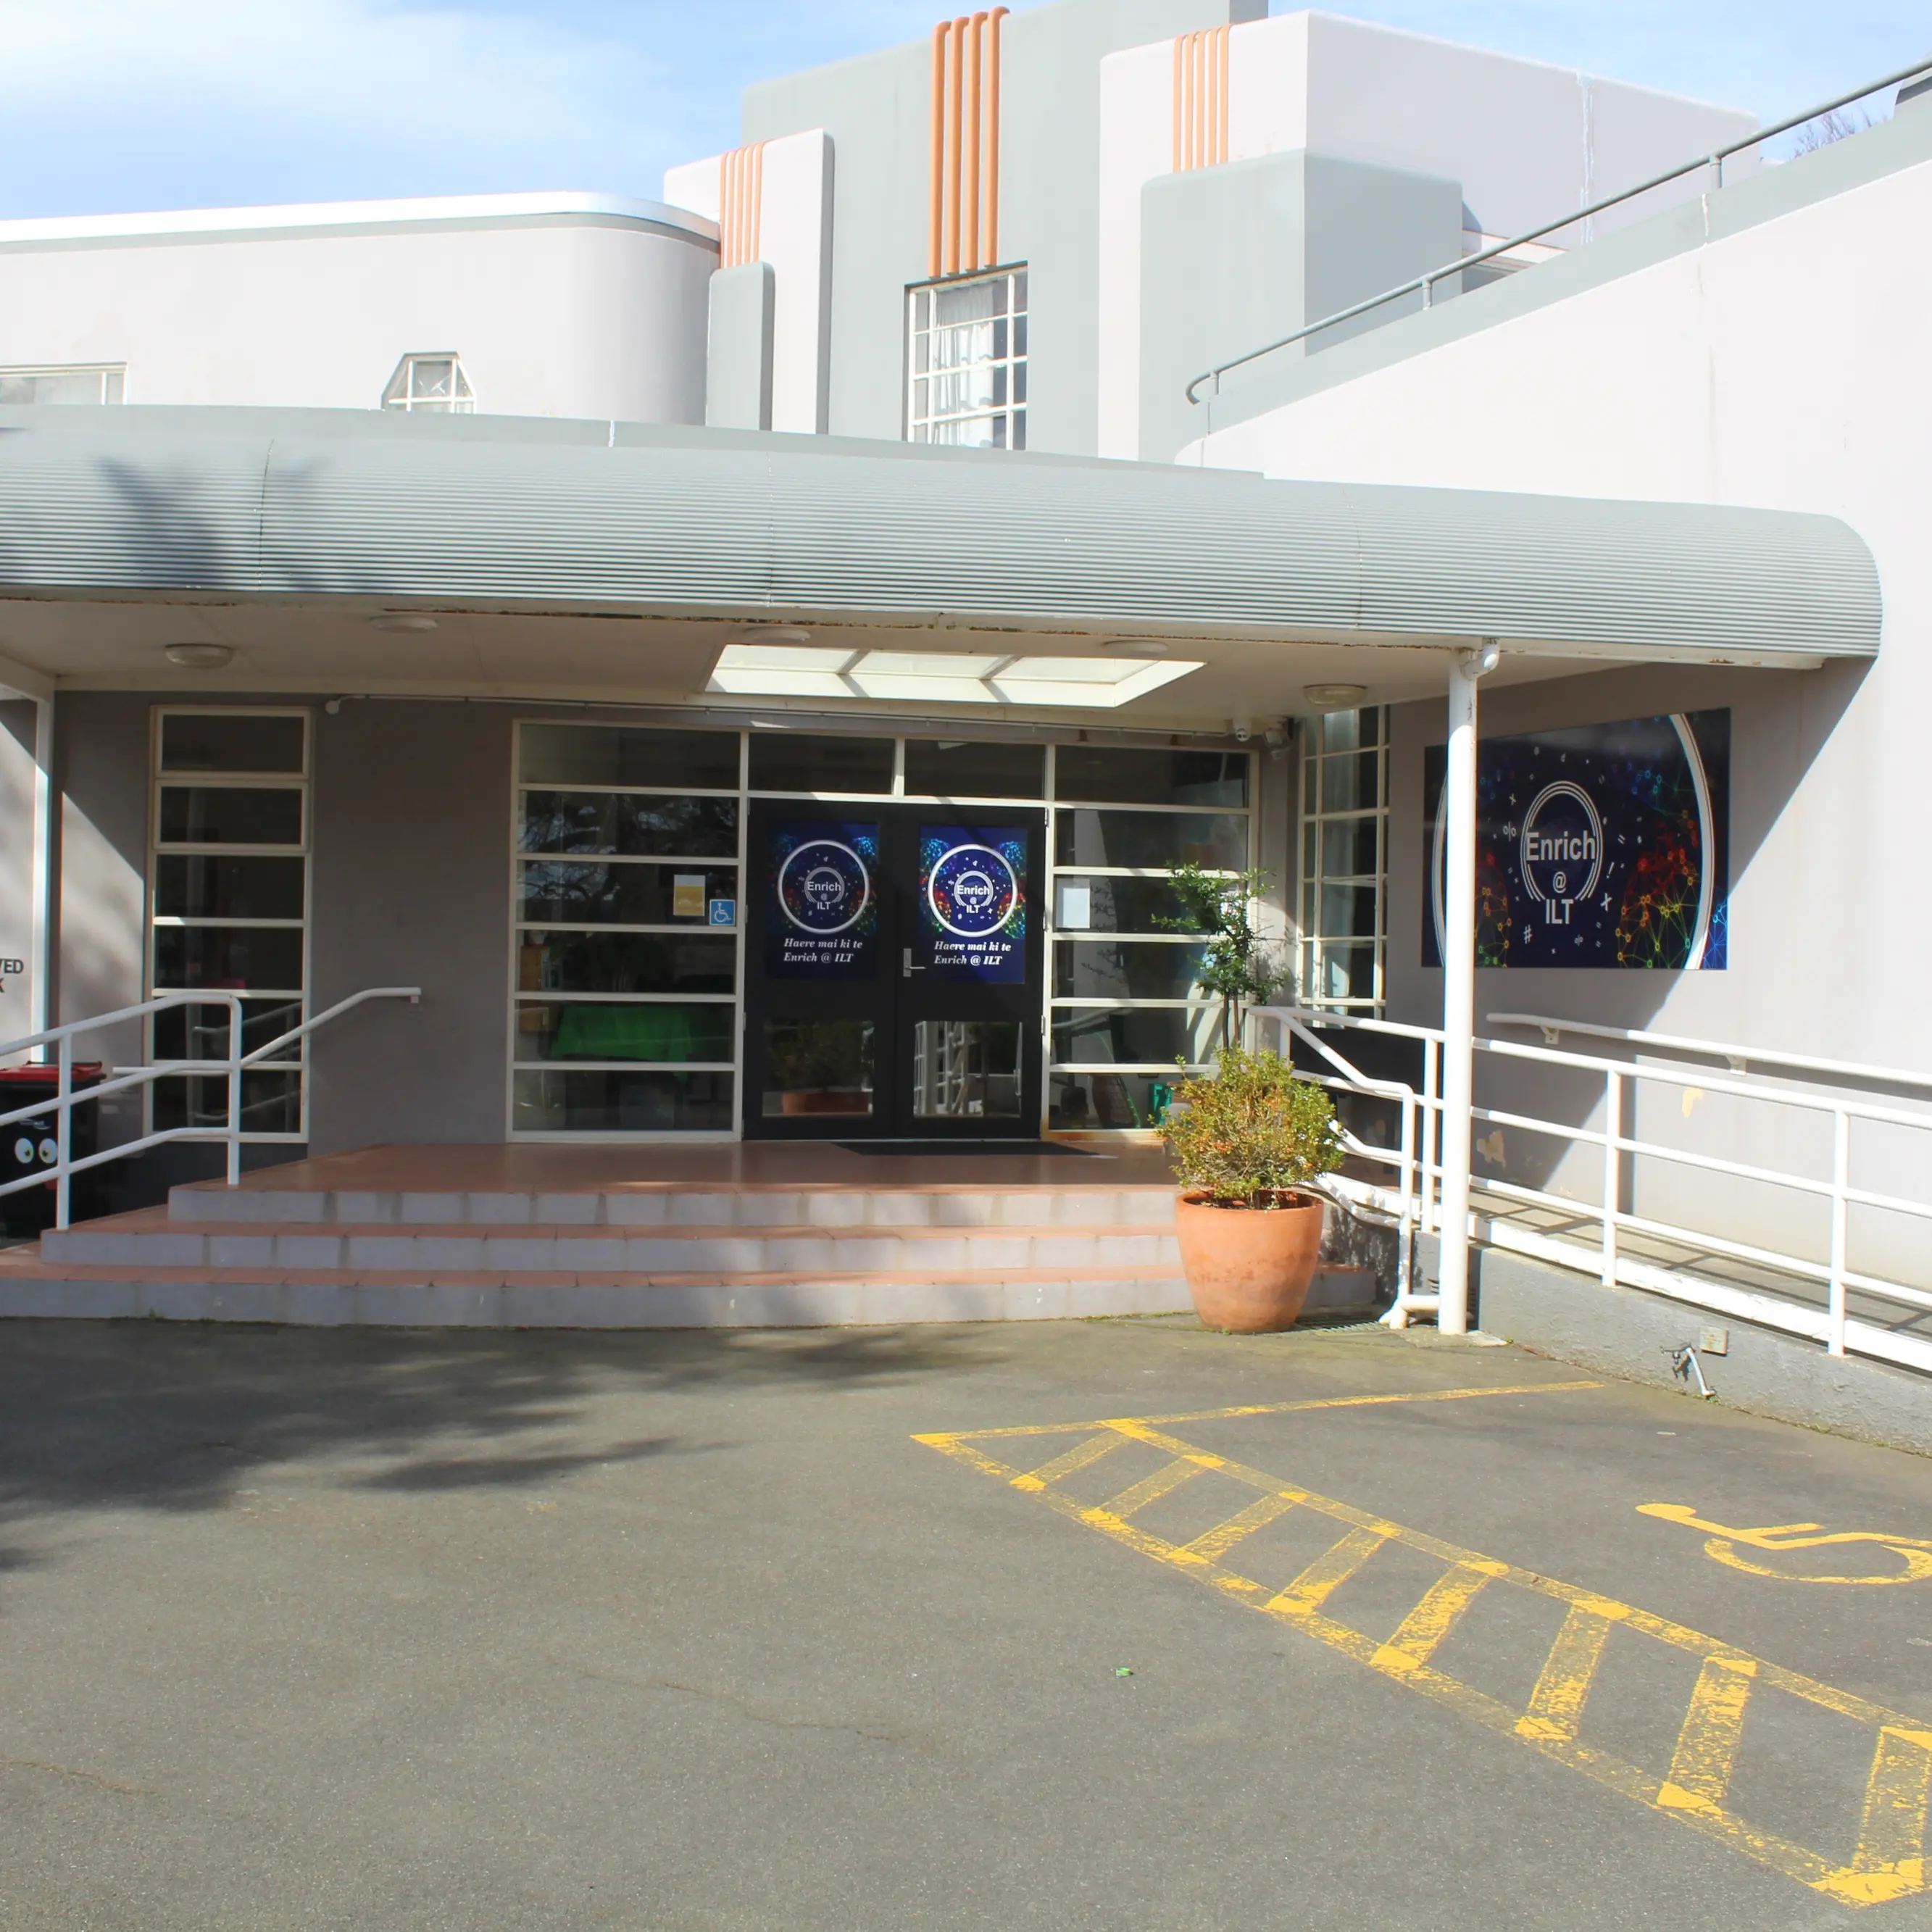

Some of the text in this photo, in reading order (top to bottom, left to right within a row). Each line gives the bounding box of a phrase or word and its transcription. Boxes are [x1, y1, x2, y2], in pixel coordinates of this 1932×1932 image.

[1525, 830, 1596, 861] Enrich
[807, 881, 841, 891] Enrich
[1553, 871, 1567, 894] @
[957, 885, 990, 896] Enrich
[817, 902, 831, 910] ILT
[970, 896, 978, 905] @
[966, 905, 980, 914] ILT
[1545, 899, 1574, 924] ILT
[783, 938, 863, 949] Haere mai ki te
[934, 941, 1012, 952] Haere mai ki te
[783, 952, 854, 964] Enrich @ ILT
[934, 954, 1003, 966] Enrich @ ILT
